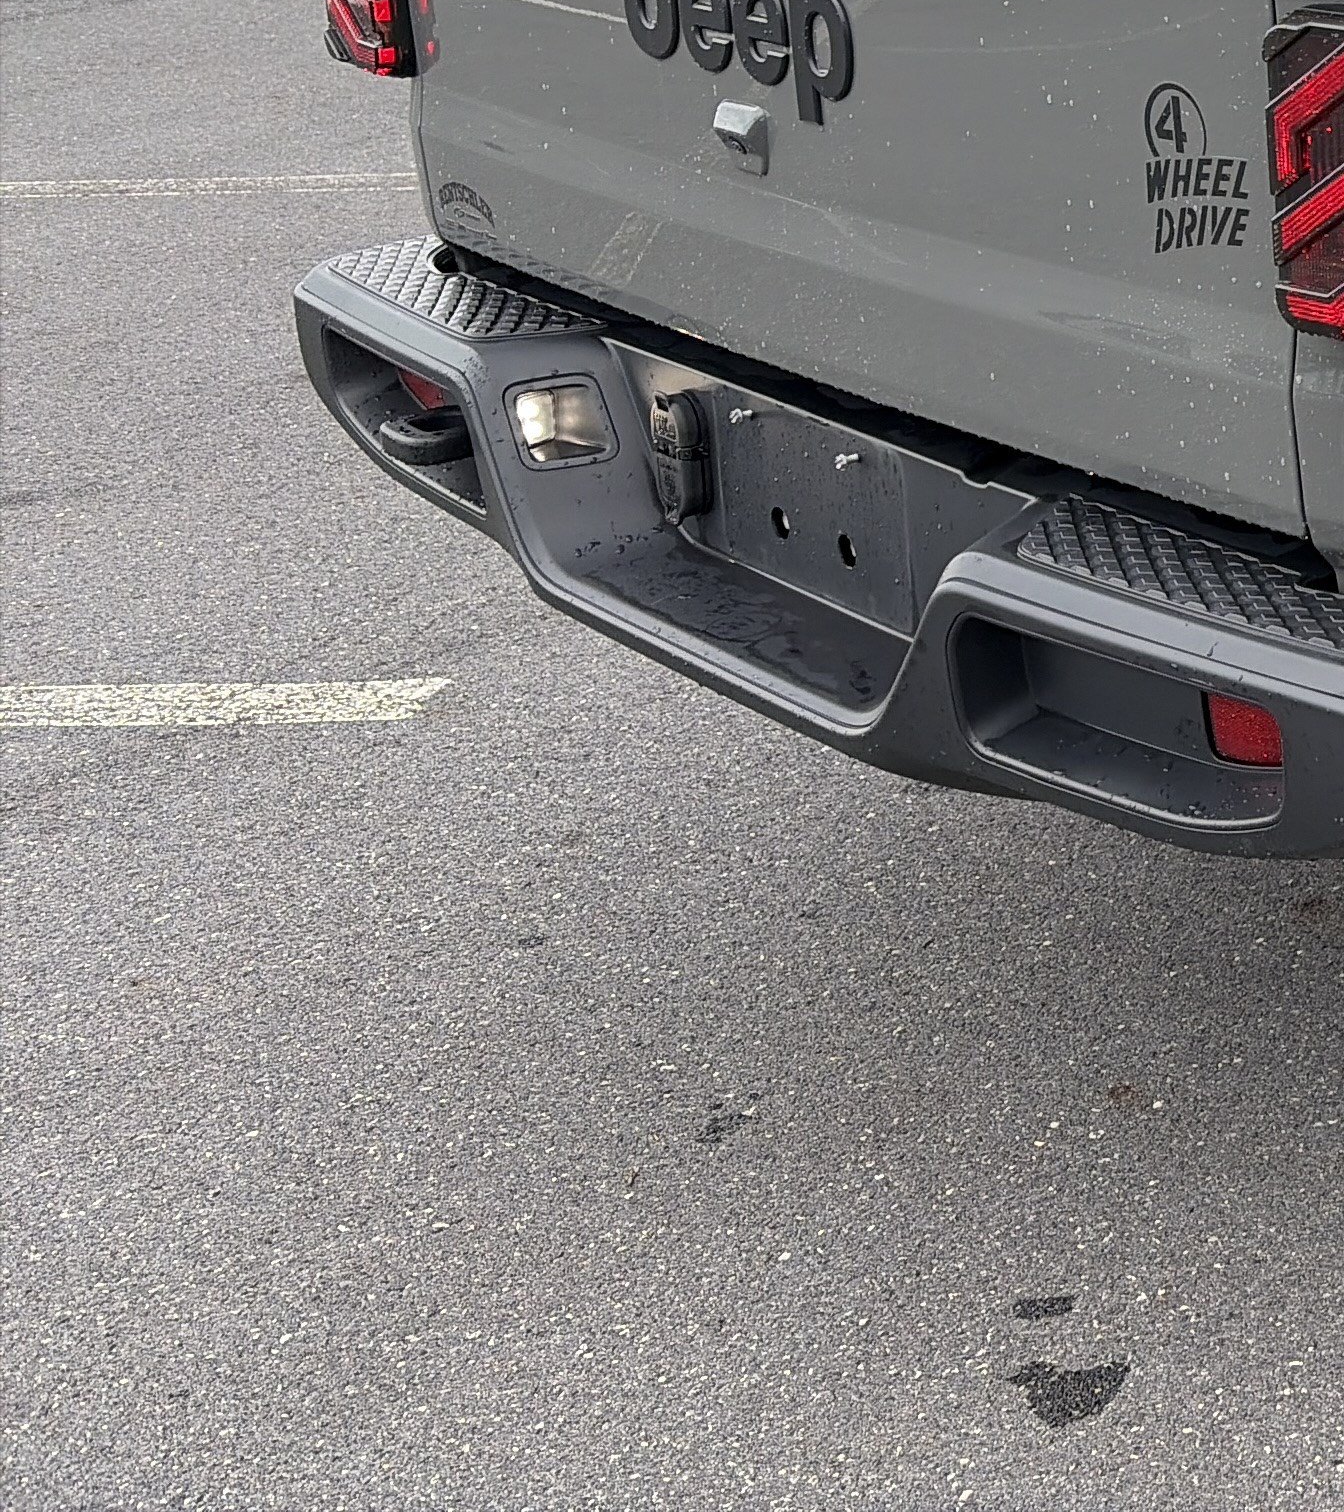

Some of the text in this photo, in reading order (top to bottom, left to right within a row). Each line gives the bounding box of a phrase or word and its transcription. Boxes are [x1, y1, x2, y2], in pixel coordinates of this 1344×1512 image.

[1154, 95, 1188, 154] 4
[1145, 157, 1250, 204] WHEEL
[1154, 204, 1251, 254] DRIVE
